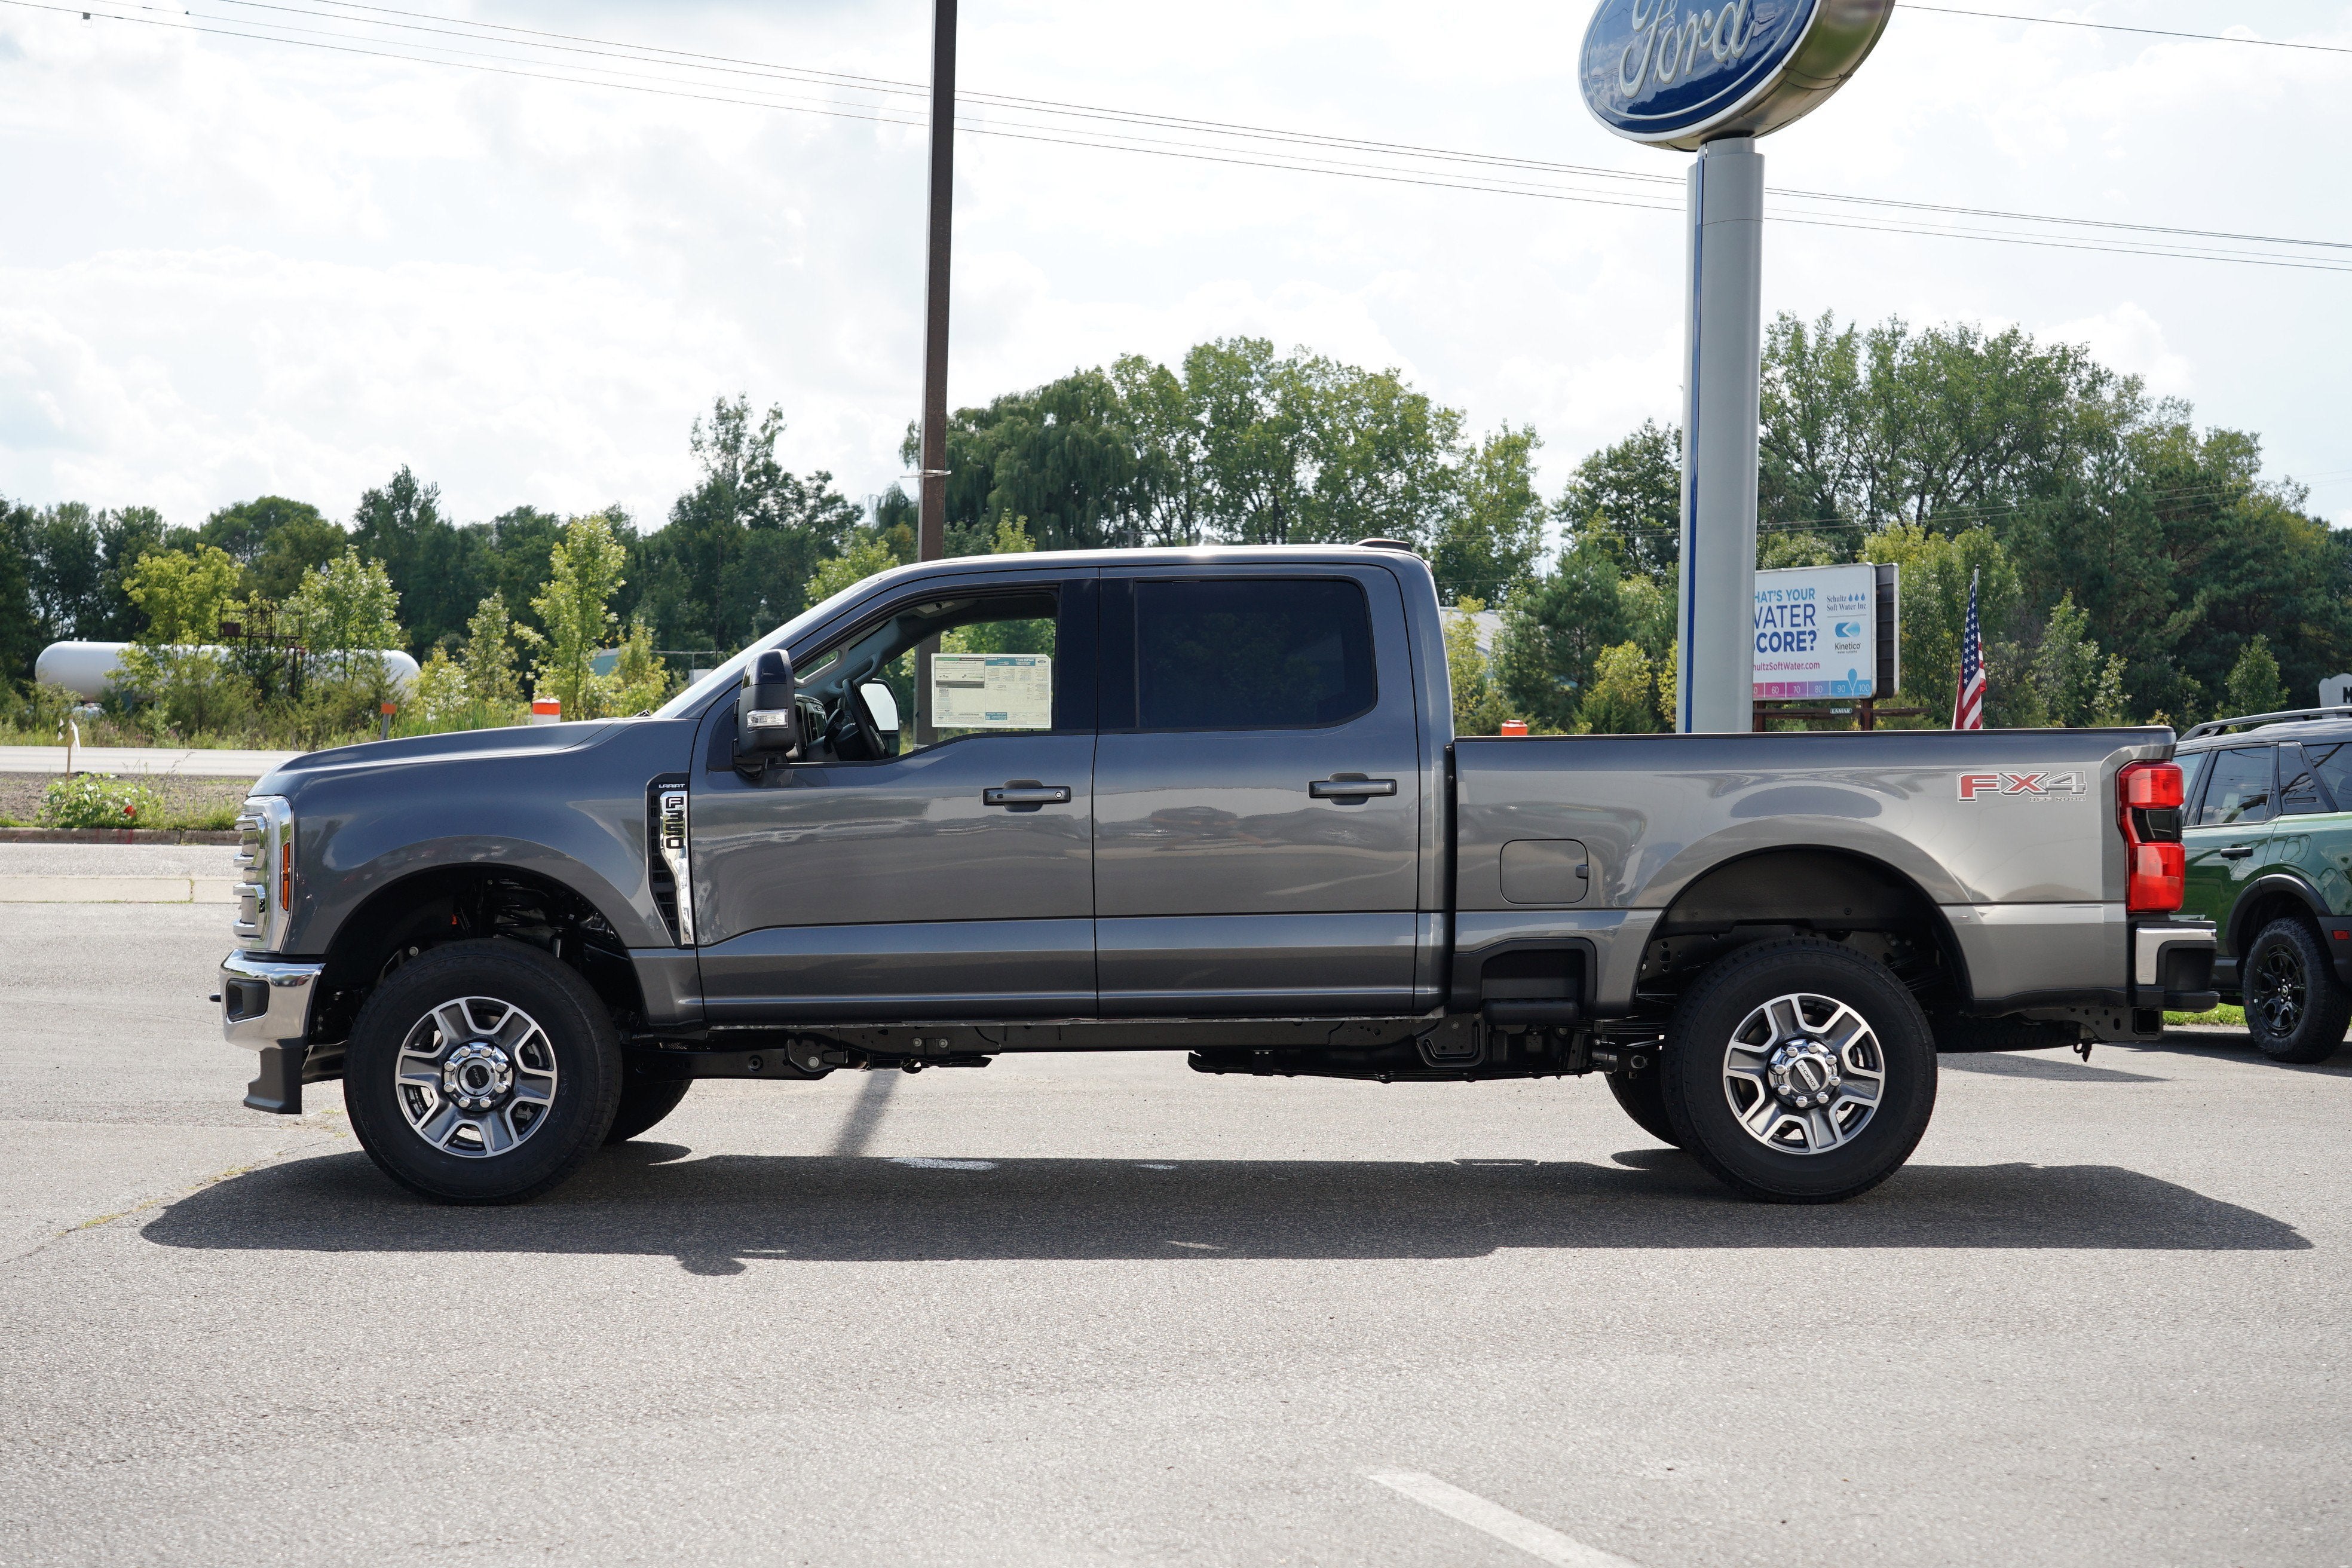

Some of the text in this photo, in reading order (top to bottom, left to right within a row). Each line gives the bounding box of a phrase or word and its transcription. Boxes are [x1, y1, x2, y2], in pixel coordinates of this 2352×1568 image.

[1619, 0, 1756, 98] Ford
[1754, 587, 1815, 603] HAT'S YOUR
[1826, 595, 1846, 603] Schultz
[1754, 630, 1817, 653] CORE?
[1835, 642, 1860, 651] Kinetico
[1753, 684, 1870, 695] 0 60 70 80 90 100
[1957, 771, 2087, 803] FX4
[1800, 1064, 1816, 1087] FORD
